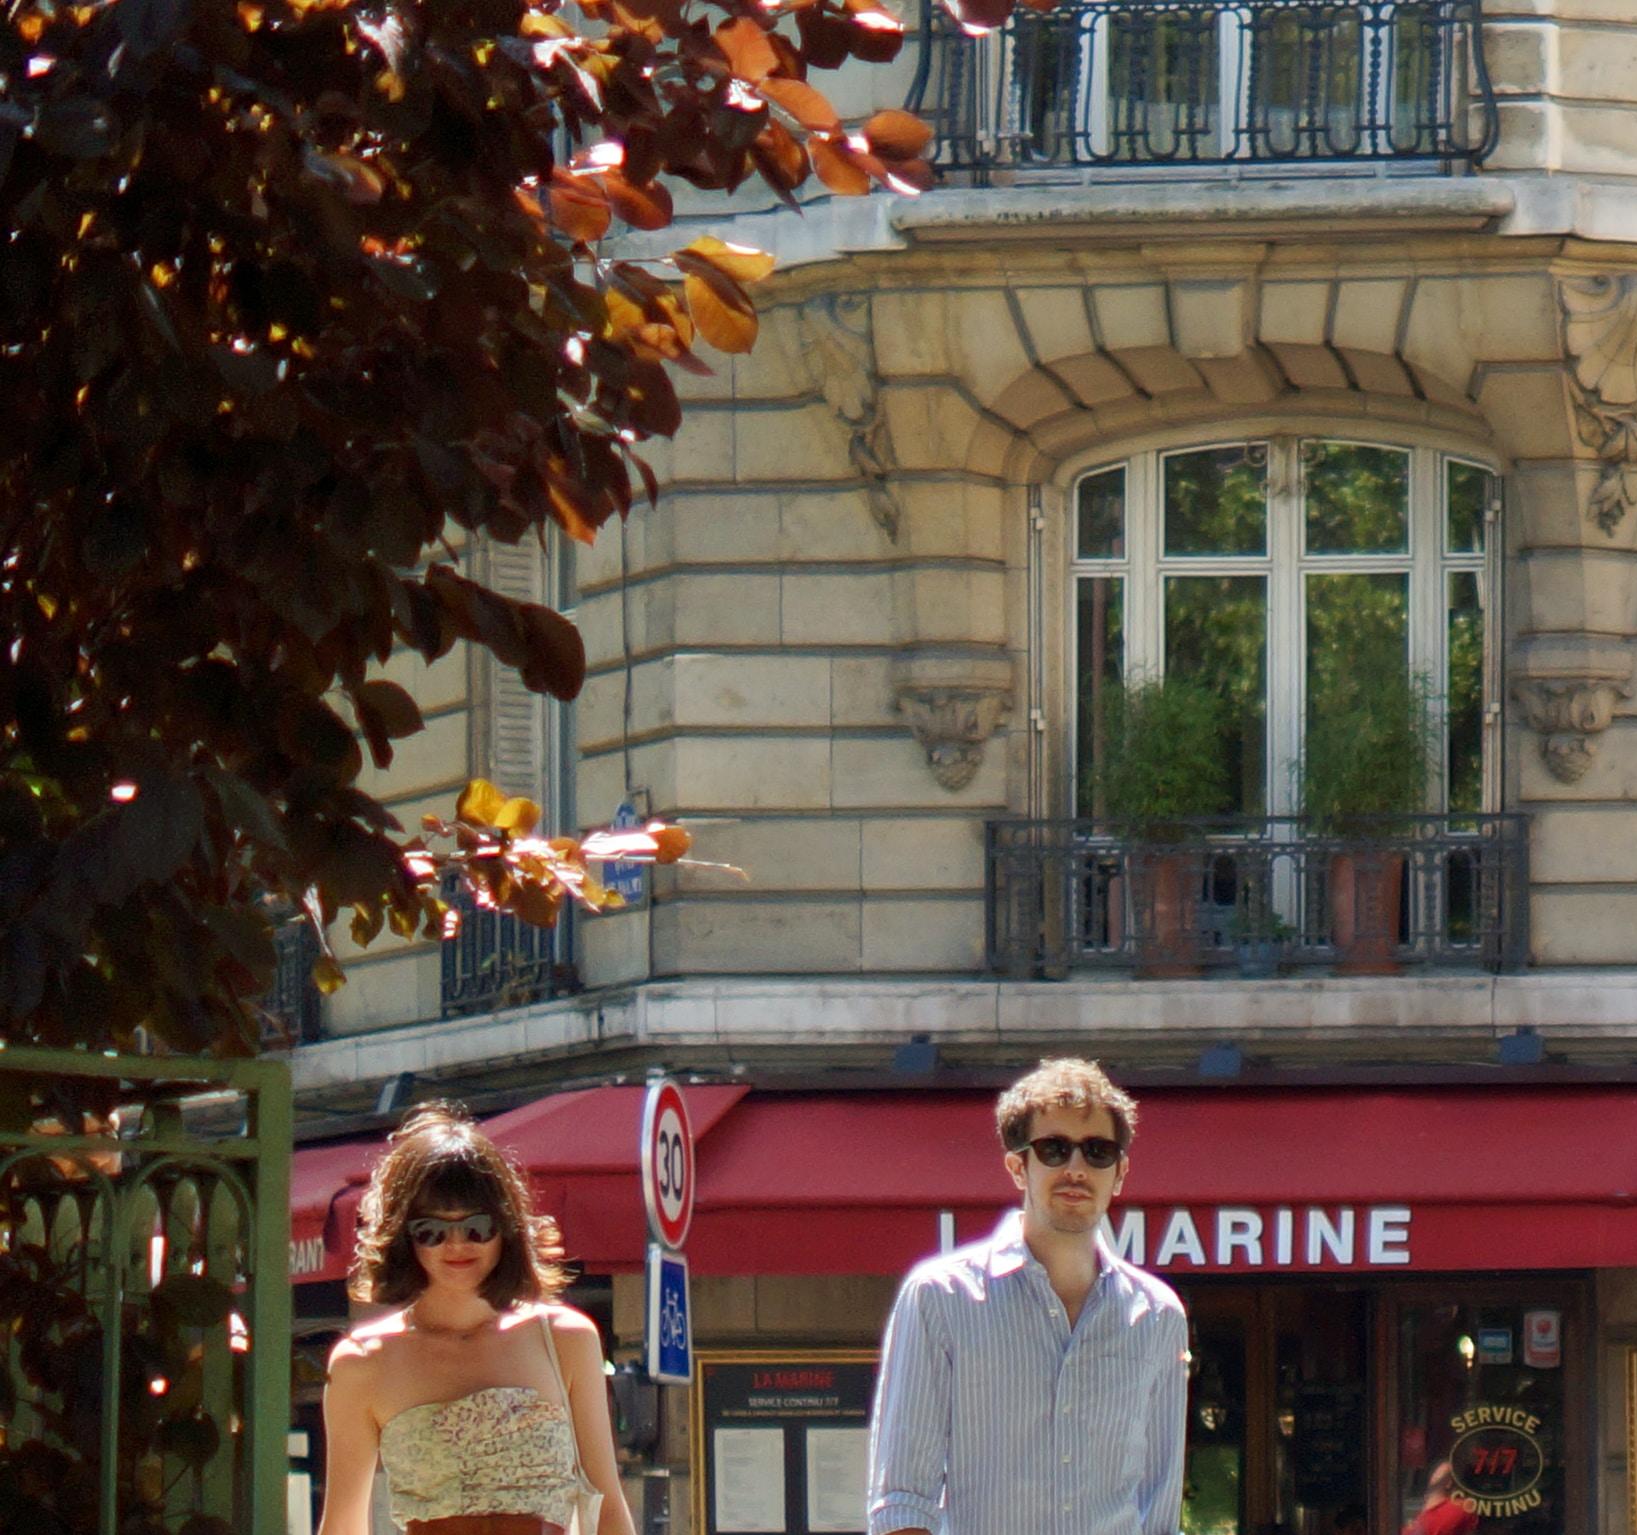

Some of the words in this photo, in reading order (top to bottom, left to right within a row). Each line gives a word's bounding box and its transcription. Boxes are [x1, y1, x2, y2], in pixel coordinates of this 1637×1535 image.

[659, 1130, 684, 1201] 30
[1099, 1209, 1412, 1265] MARINE
[1451, 1406, 1541, 1434] SERVICE
[1472, 1447, 1518, 1475] 7/7
[1451, 1489, 1543, 1518] CONTINU
